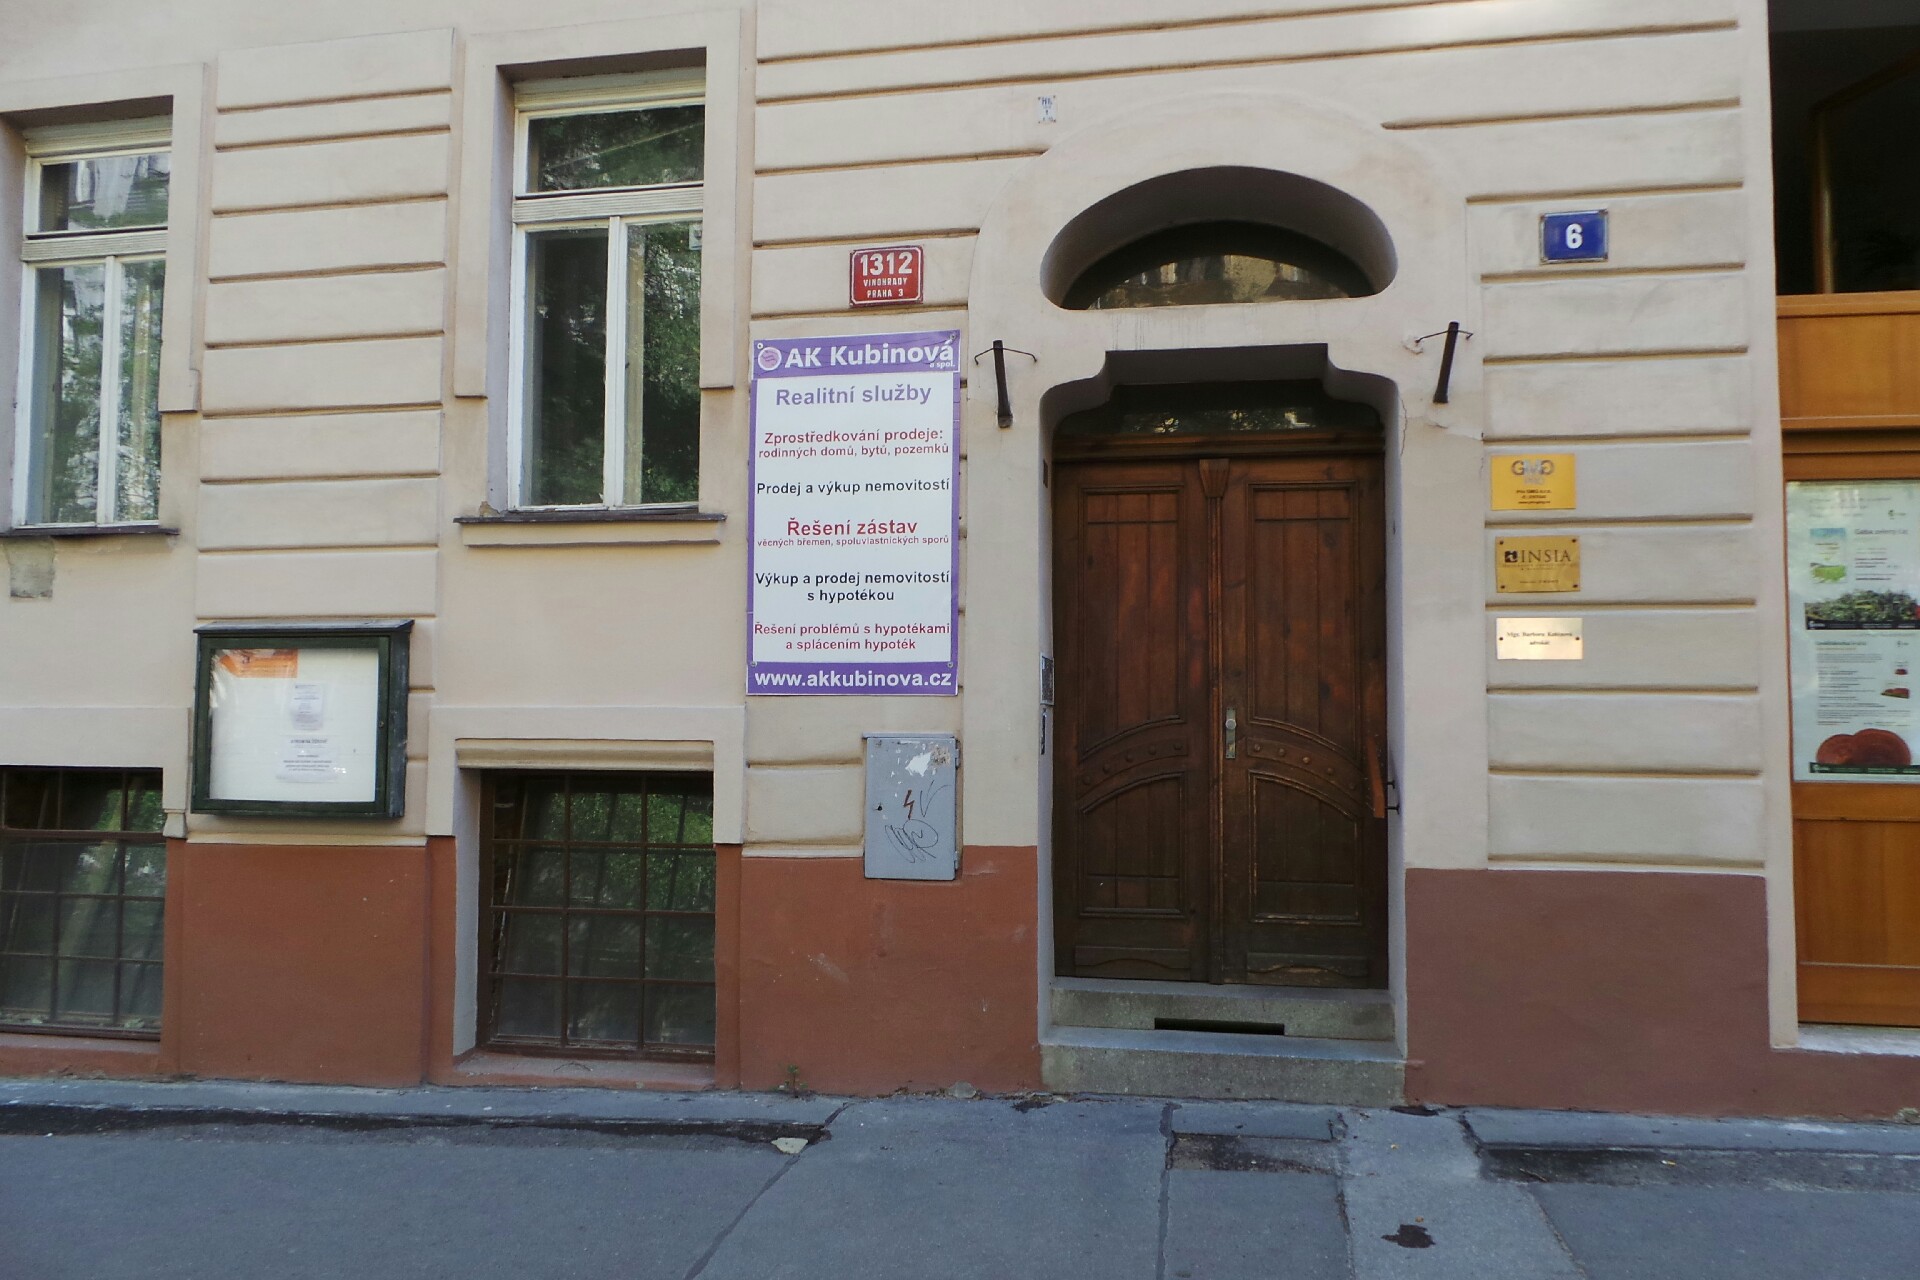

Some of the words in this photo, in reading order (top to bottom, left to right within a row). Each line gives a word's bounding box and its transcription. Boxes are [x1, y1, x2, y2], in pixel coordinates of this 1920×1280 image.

[1566, 223, 1583, 249] 6
[860, 251, 913, 276] 1312
[863, 277, 908, 287] VINOHRADY
[866, 289, 893, 298] PRAHA
[898, 288, 904, 297] 3
[784, 347, 822, 368] AK
[830, 339, 954, 366] Kubinová
[936, 360, 956, 369] spol.
[776, 386, 855, 406] Realitní
[862, 383, 932, 405] služby
[764, 428, 880, 447] Zprostředkování
[884, 428, 943, 443] prodeje:
[758, 446, 817, 460] rodinných
[820, 445, 857, 458] domů,
[861, 444, 891, 457] bytů,
[894, 443, 949, 457] pozemků
[757, 482, 802, 497] Prodej
[805, 485, 813, 494] a
[818, 481, 860, 496] výkup
[865, 478, 950, 492] nemovitostí
[787, 517, 851, 536] Řešení
[856, 519, 918, 535] zástav
[757, 537, 795, 549] věcných
[835, 535, 919, 547] spoluvlastnických
[922, 534, 949, 546] sporů
[1521, 549, 1571, 562] INSIA
[755, 572, 799, 588] Výkup
[803, 575, 811, 584] a
[815, 571, 860, 587] prodej
[865, 570, 950, 584] nemovitostí
[807, 592, 815, 601] s
[820, 589, 895, 604] hypotékou
[754, 621, 796, 635] Řešení
[800, 622, 860, 637] problémů
[864, 625, 871, 634] s
[875, 622, 950, 637] hypotékami
[786, 641, 793, 650] a
[797, 638, 861, 652] splácením
[864, 638, 916, 652] hypoték
[754, 670, 952, 687] www.akkubinova.cz
